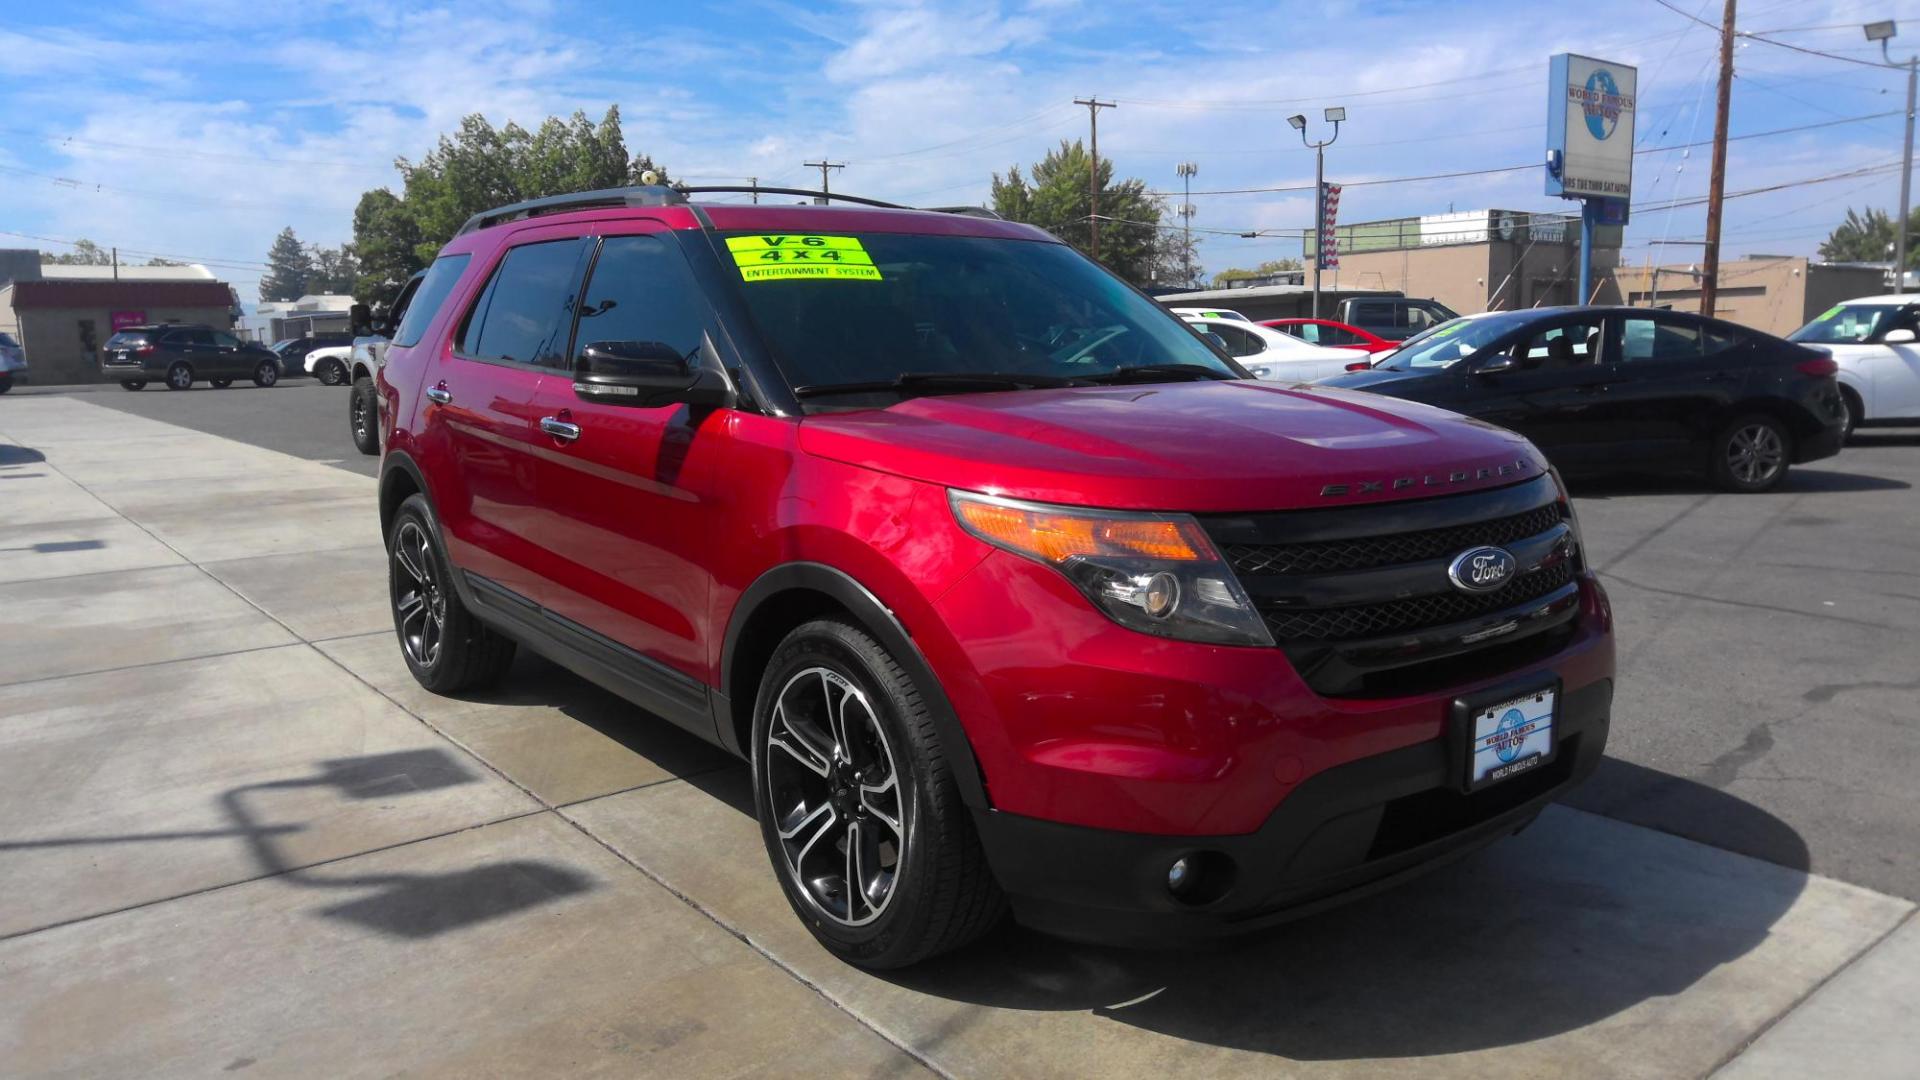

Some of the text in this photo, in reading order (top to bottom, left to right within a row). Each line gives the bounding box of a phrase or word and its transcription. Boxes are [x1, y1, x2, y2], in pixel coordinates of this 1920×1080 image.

[1569, 87, 1599, 101] WORLD
[762, 237, 825, 247] V-6
[746, 267, 876, 278] ENTERTAINMENT SYSTEM
[1320, 460, 1527, 496] EXPLORER
[1472, 555, 1505, 583] Ford
[1487, 732, 1508, 745] WORLD
[1496, 735, 1525, 752] AUTOS
[1492, 765, 1508, 780] WORLD
